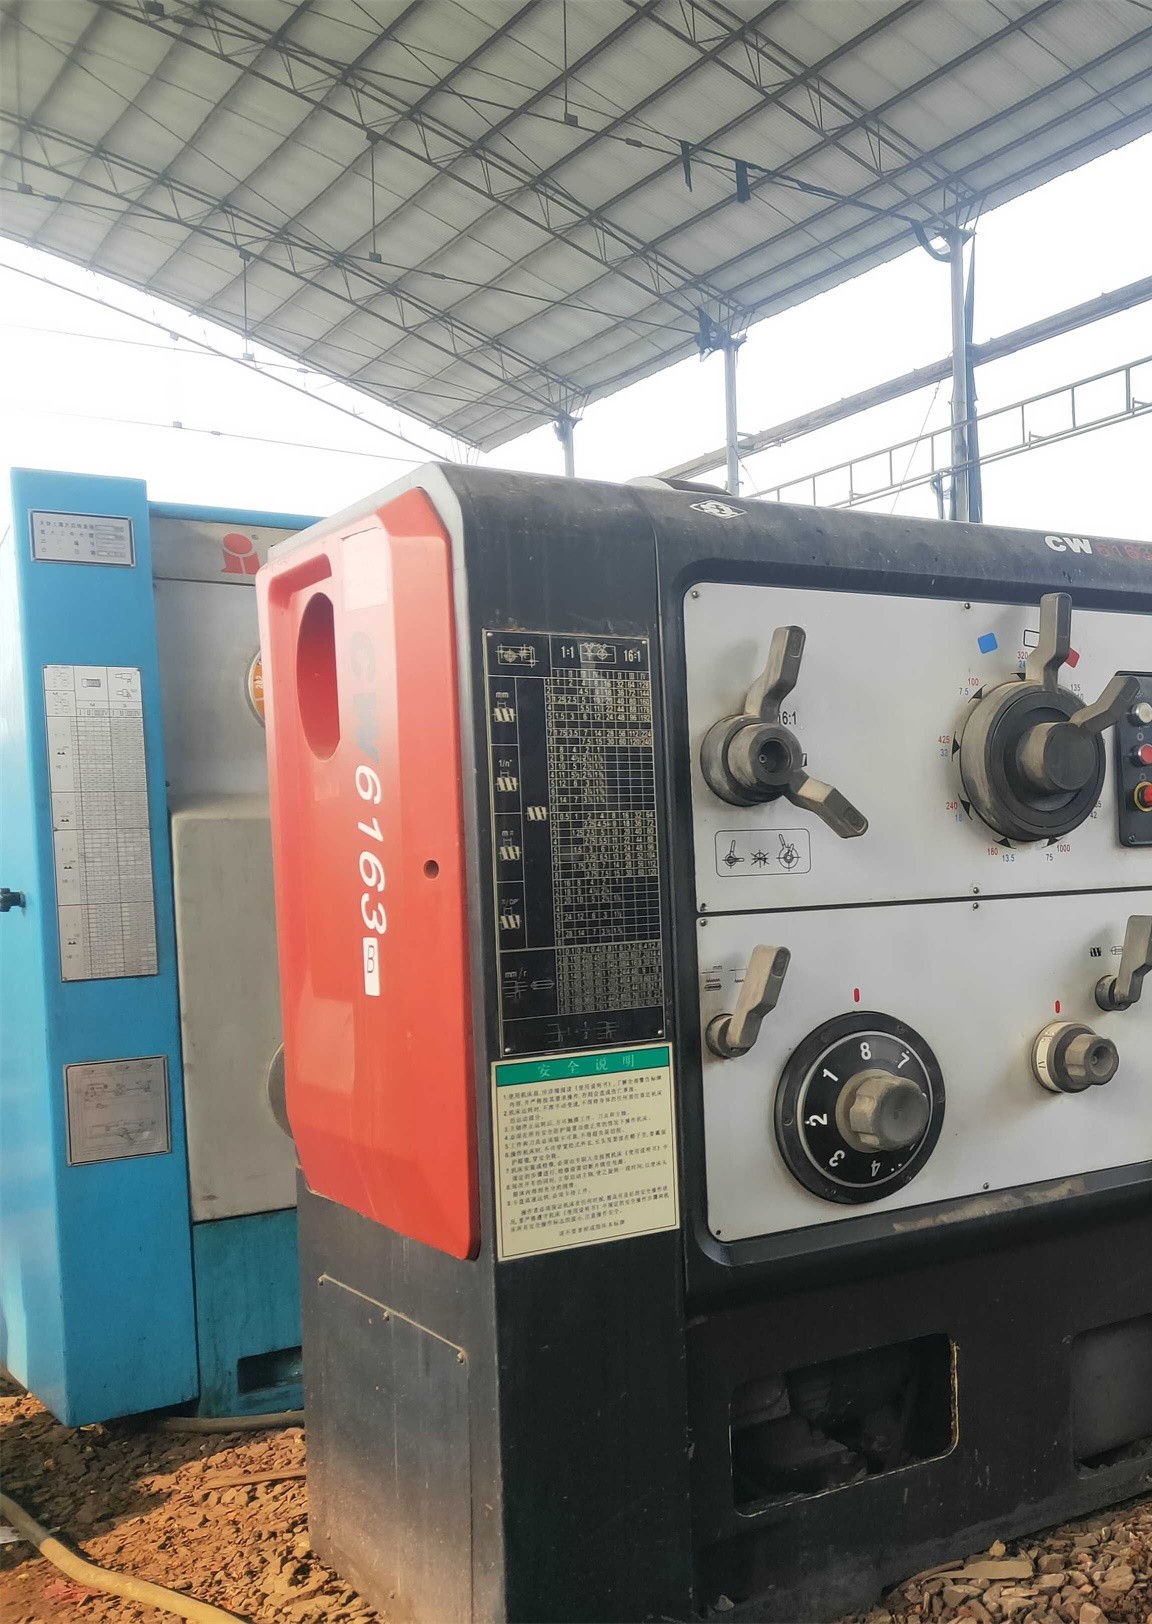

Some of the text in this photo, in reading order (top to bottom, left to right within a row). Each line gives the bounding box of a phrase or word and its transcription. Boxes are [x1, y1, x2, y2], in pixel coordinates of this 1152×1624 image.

[1044, 535, 1092, 554] CW
[968, 678, 979, 686] 100
[938, 736, 950, 744] 425
[940, 749, 948, 757] 32
[355, 764, 386, 934] 6163
[1056, 844, 1071, 852] 1000
[1002, 854, 1015, 862] 13.5
[860, 1042, 872, 1060] 8
[537, 1054, 634, 1078] 安全说明
[897, 1051, 910, 1068] 7
[822, 1068, 839, 1082] 1
[808, 1113, 828, 1126] 2
[829, 1150, 846, 1167] 3
[871, 1160, 881, 1177] 4
